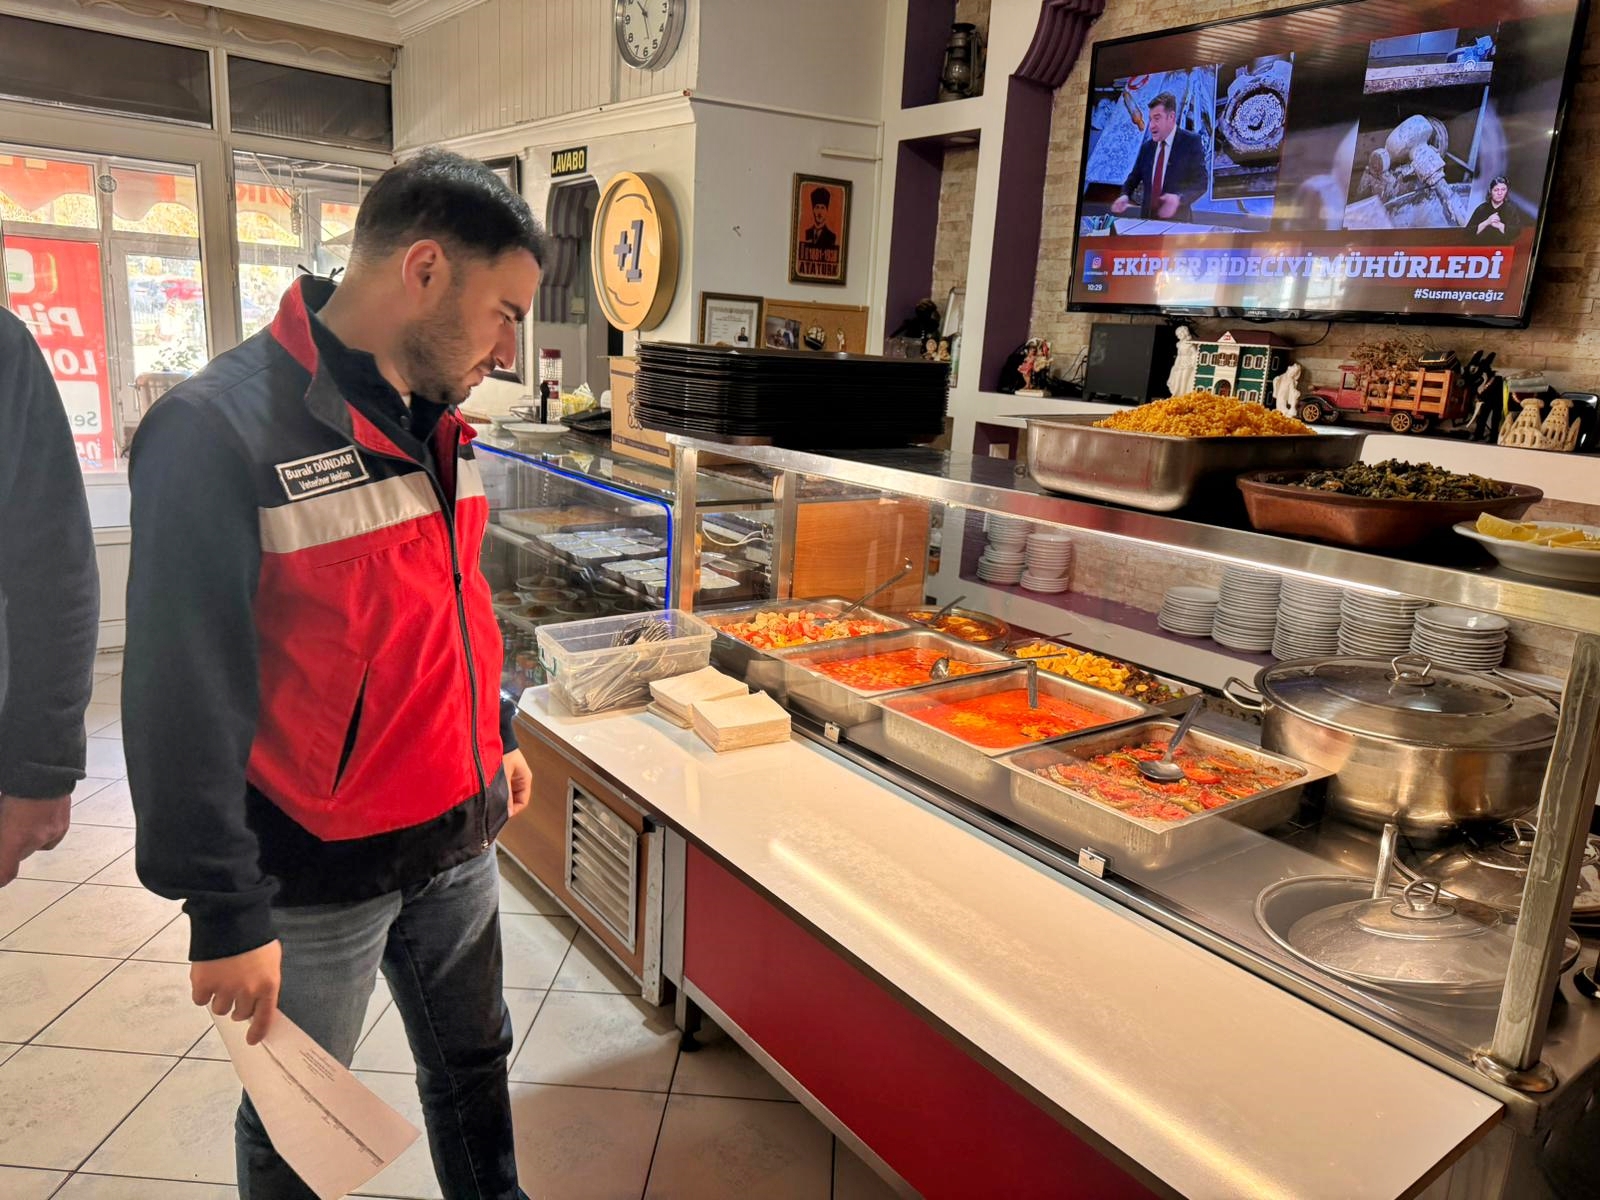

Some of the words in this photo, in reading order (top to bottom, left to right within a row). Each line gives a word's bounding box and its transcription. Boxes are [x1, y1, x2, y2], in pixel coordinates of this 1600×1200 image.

[551, 150, 585, 174] LAVABO
[1112, 253, 1203, 276] EKİPLER
[1206, 252, 1313, 277] PİDECİYİ
[1319, 251, 1503, 279] MÜHÜRLEDİ
[1414, 288, 1504, 301] #Susmayacağız
[285, 463, 314, 480] Burak
[312, 454, 355, 472] DÜNDAR
